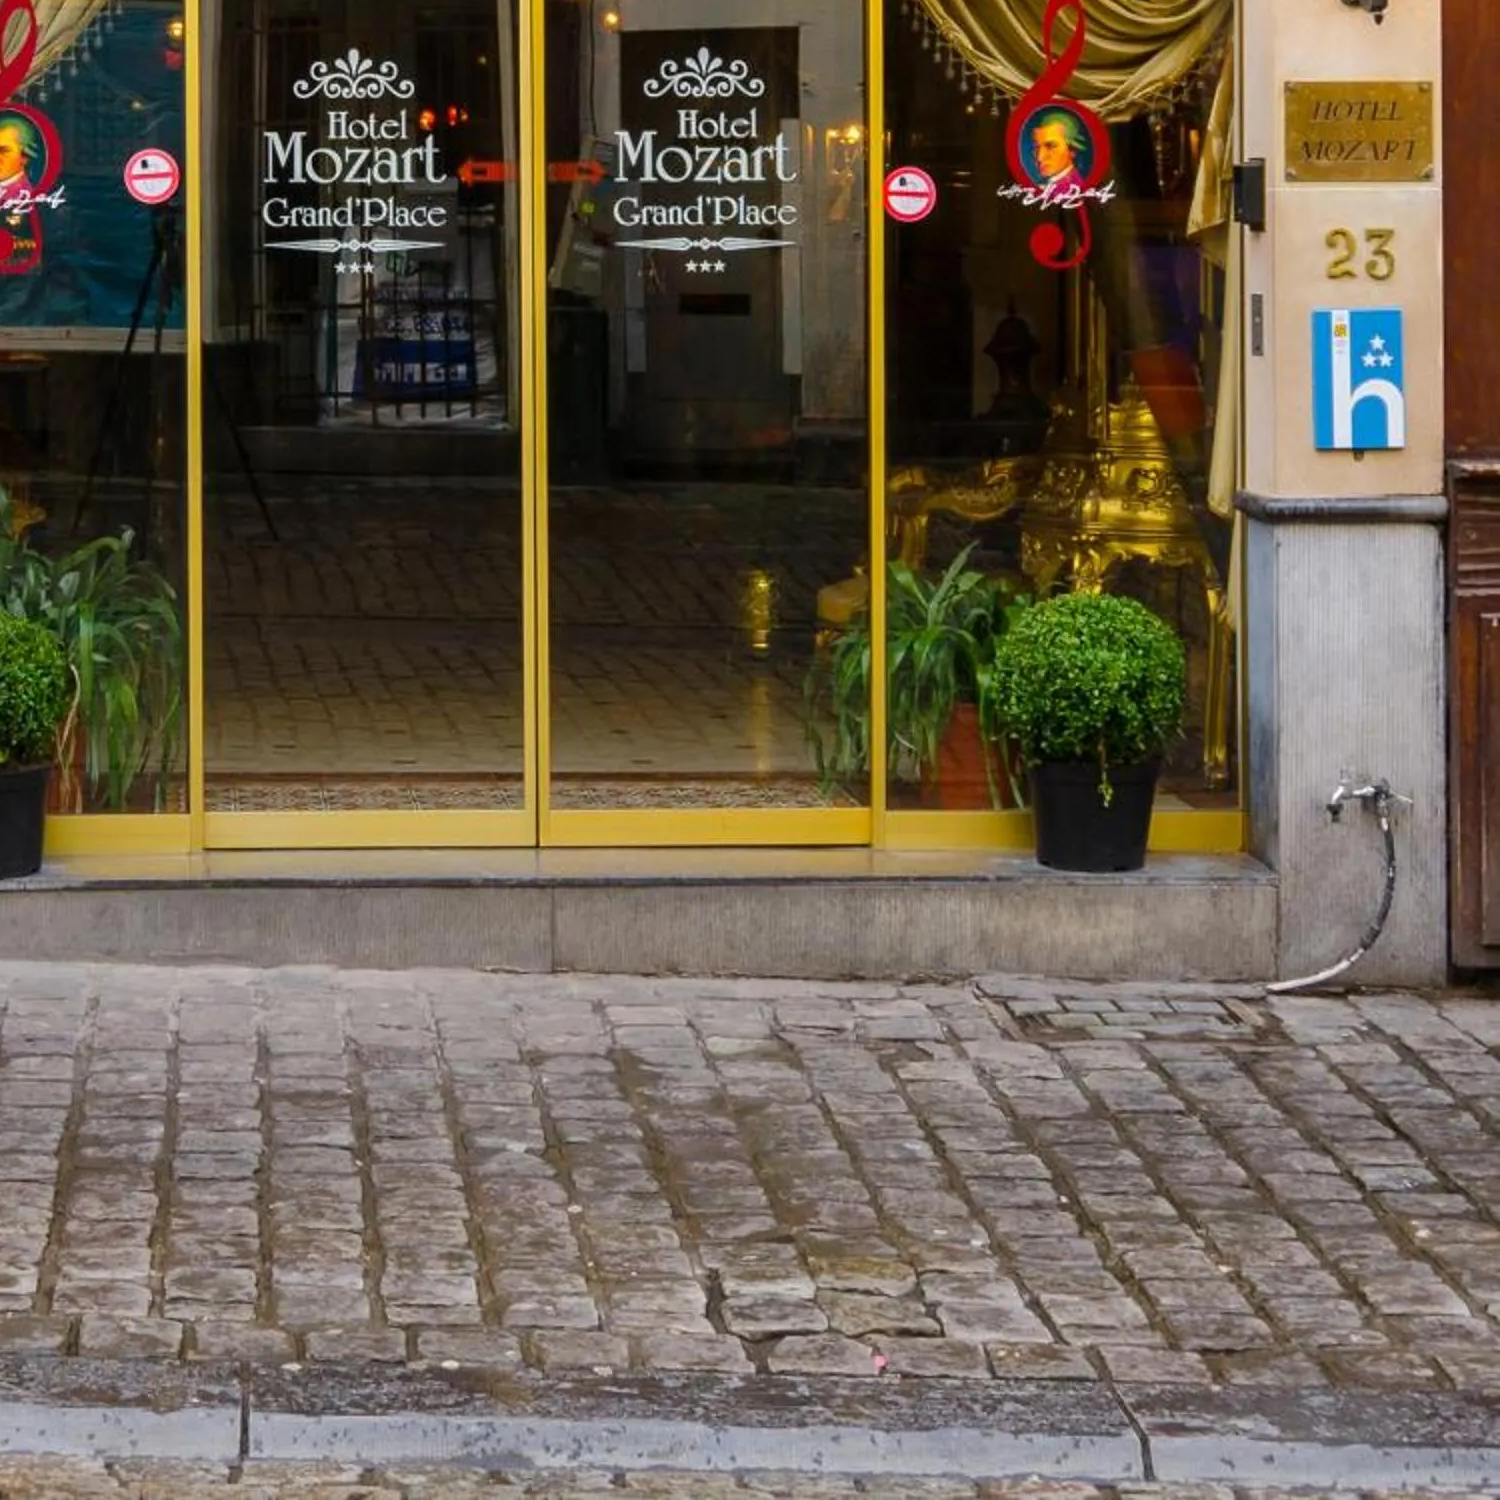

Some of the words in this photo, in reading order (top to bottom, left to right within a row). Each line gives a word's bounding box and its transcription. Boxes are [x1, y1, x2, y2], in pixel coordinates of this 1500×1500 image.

[327, 108, 409, 140] Hotel
[677, 108, 758, 140] Hotel
[1310, 100, 1404, 122] HOTEL
[263, 132, 448, 186] Mozart
[614, 130, 798, 186] Mozart
[1301, 139, 1418, 162] MOZART
[262, 196, 448, 228] Grand'Place
[613, 195, 798, 227] Grand'Place
[1324, 228, 1396, 281] 23
